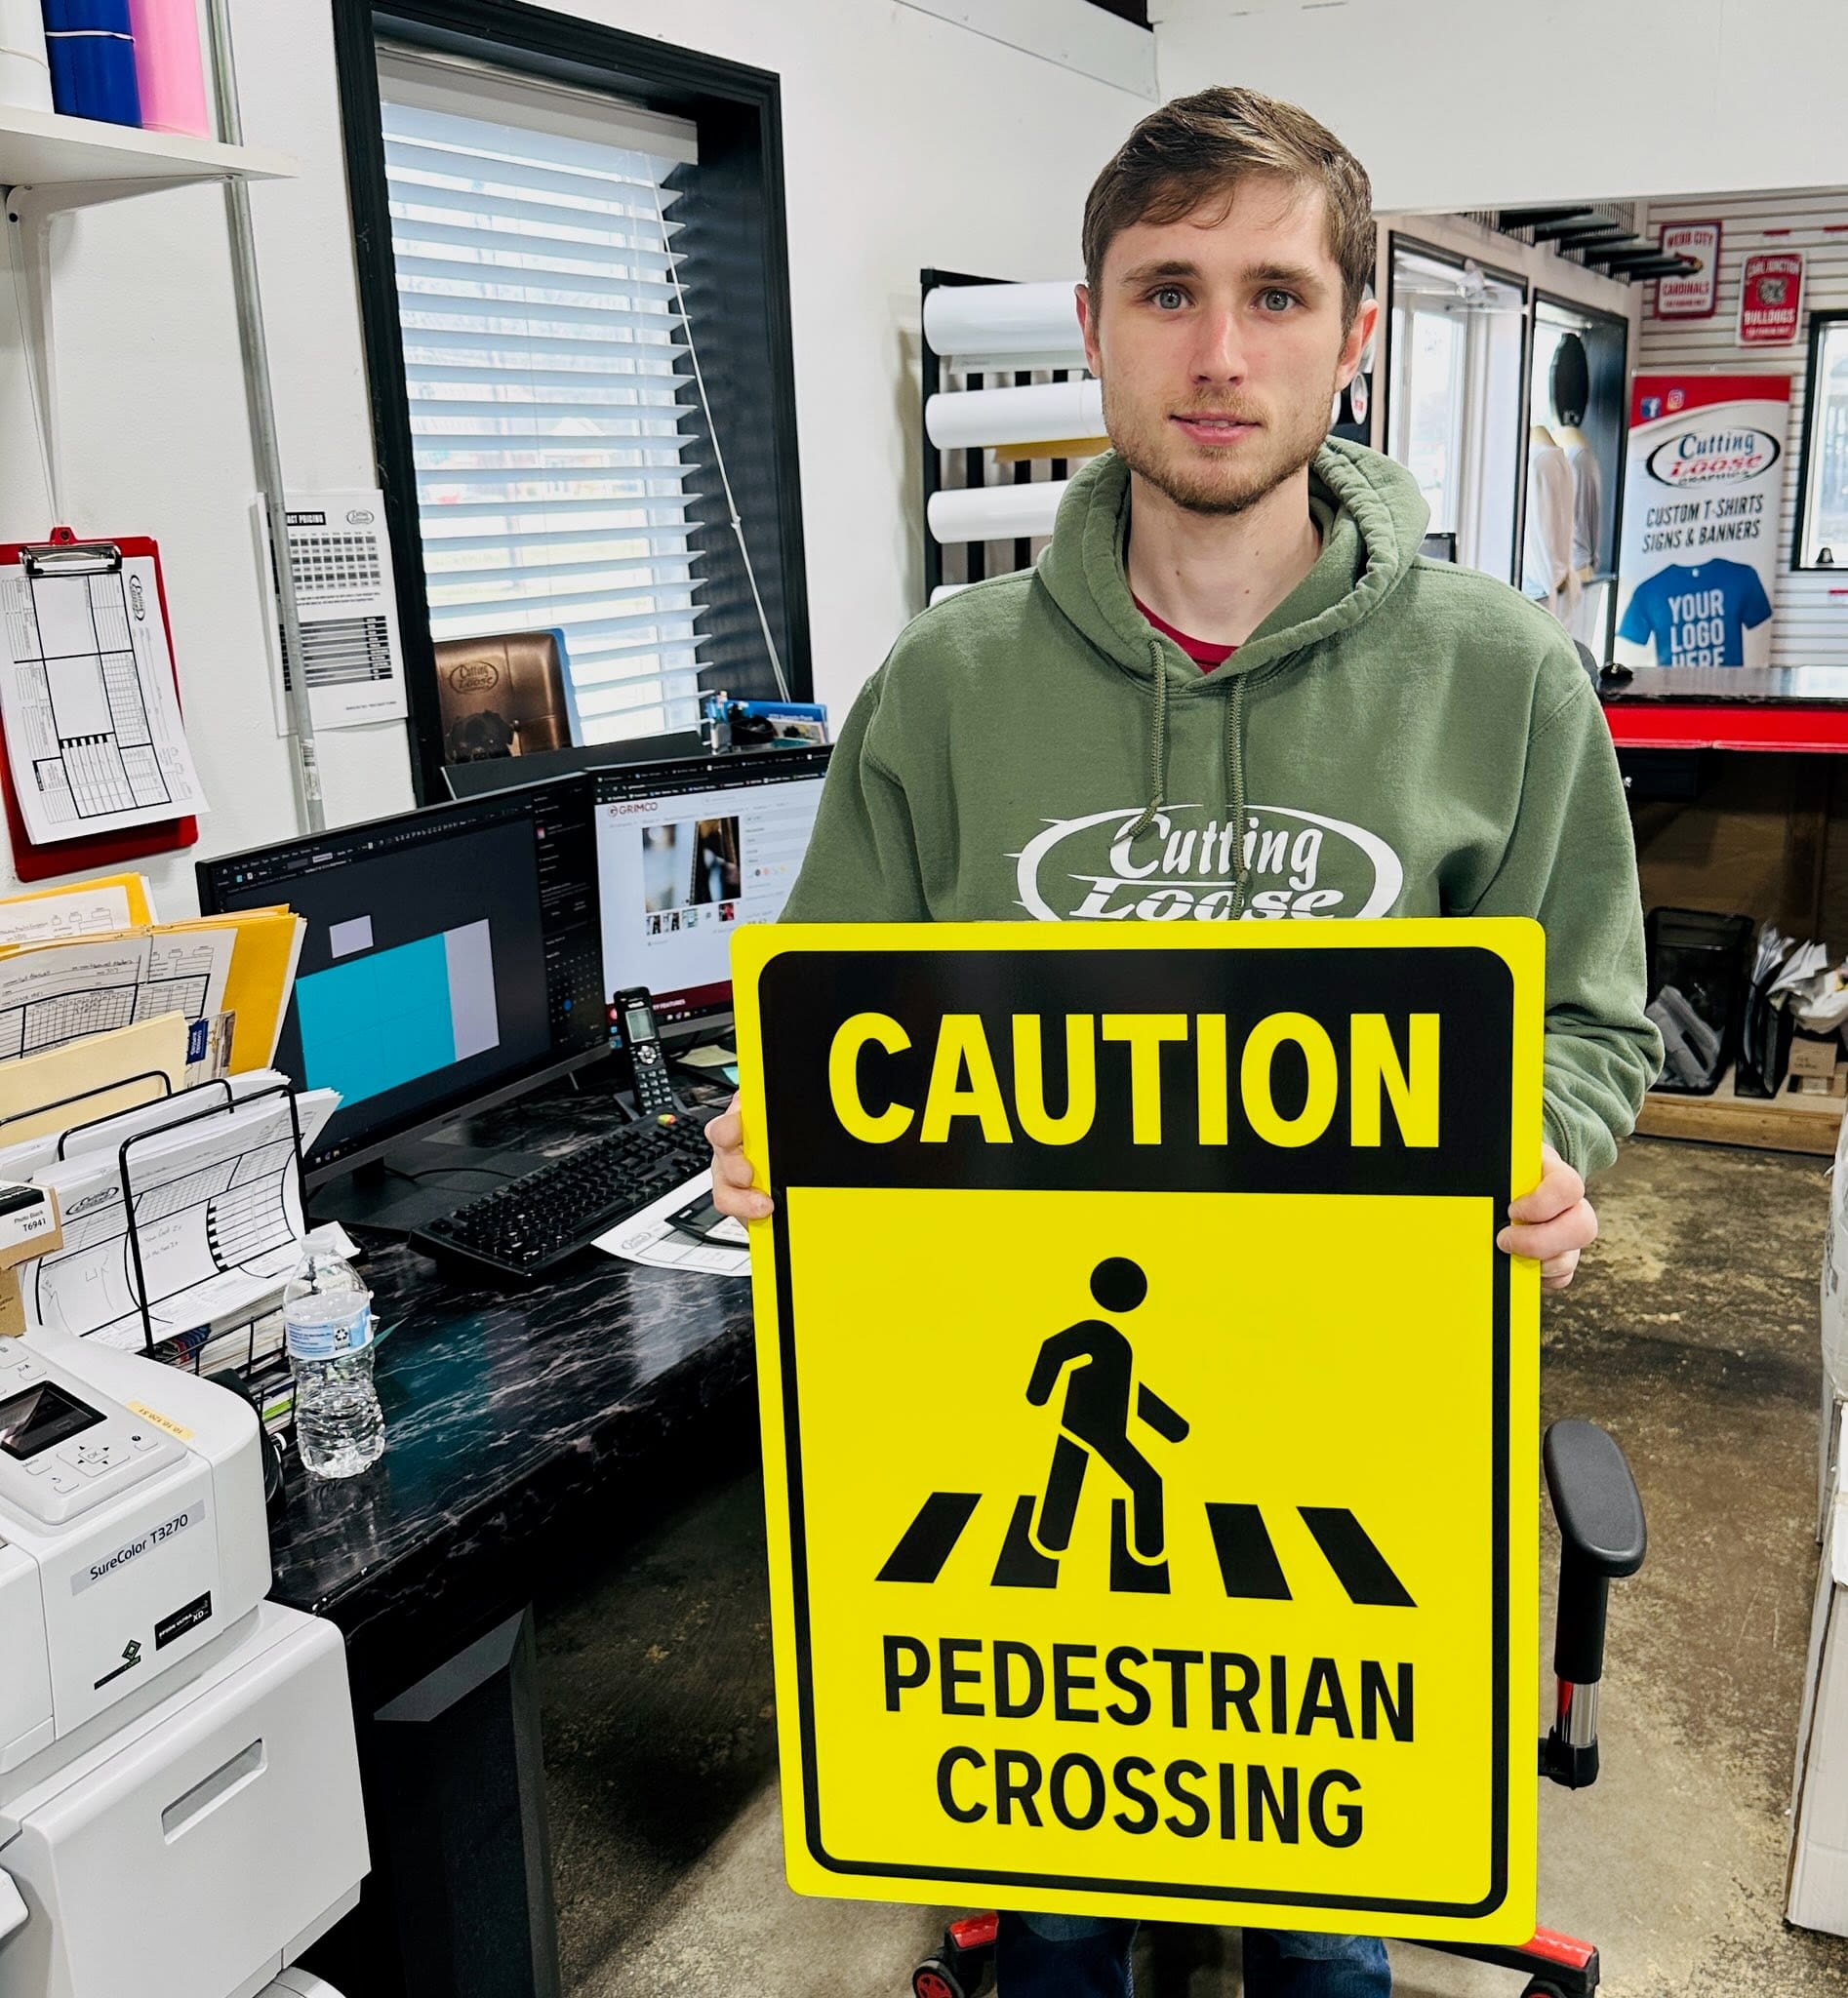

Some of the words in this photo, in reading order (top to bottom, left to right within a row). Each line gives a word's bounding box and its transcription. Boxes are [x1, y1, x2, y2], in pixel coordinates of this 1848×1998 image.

[1694, 230, 1713, 246] CITY
[1662, 280, 1710, 296] CARDINALS
[1744, 308, 1795, 325] BULLDOGS
[1678, 432, 1755, 460] Cutting
[1646, 501, 1701, 528] CUSTOM
[1703, 494, 1764, 522] T-SHIRTS
[1641, 530, 1682, 554] SIGNS
[1685, 527, 1695, 547] &
[1698, 519, 1761, 545] BANNERS
[1667, 588, 1725, 624] YOUR
[1669, 618, 1725, 654] LOGO
[619, 802, 658, 816] GRIMCO
[1109, 813, 1323, 892] Cutting
[829, 1013, 1440, 1148] CAUTION
[22, 1218, 47, 1232] T6941
[87, 1451, 101, 1459] OK
[89, 1538, 147, 1581] SureColor
[149, 1513, 189, 1545] T3270
[192, 1610, 204, 1622] XD
[882, 1635, 1415, 1743] PEDESTRIAN
[937, 1745, 1364, 1849] CROSSING
